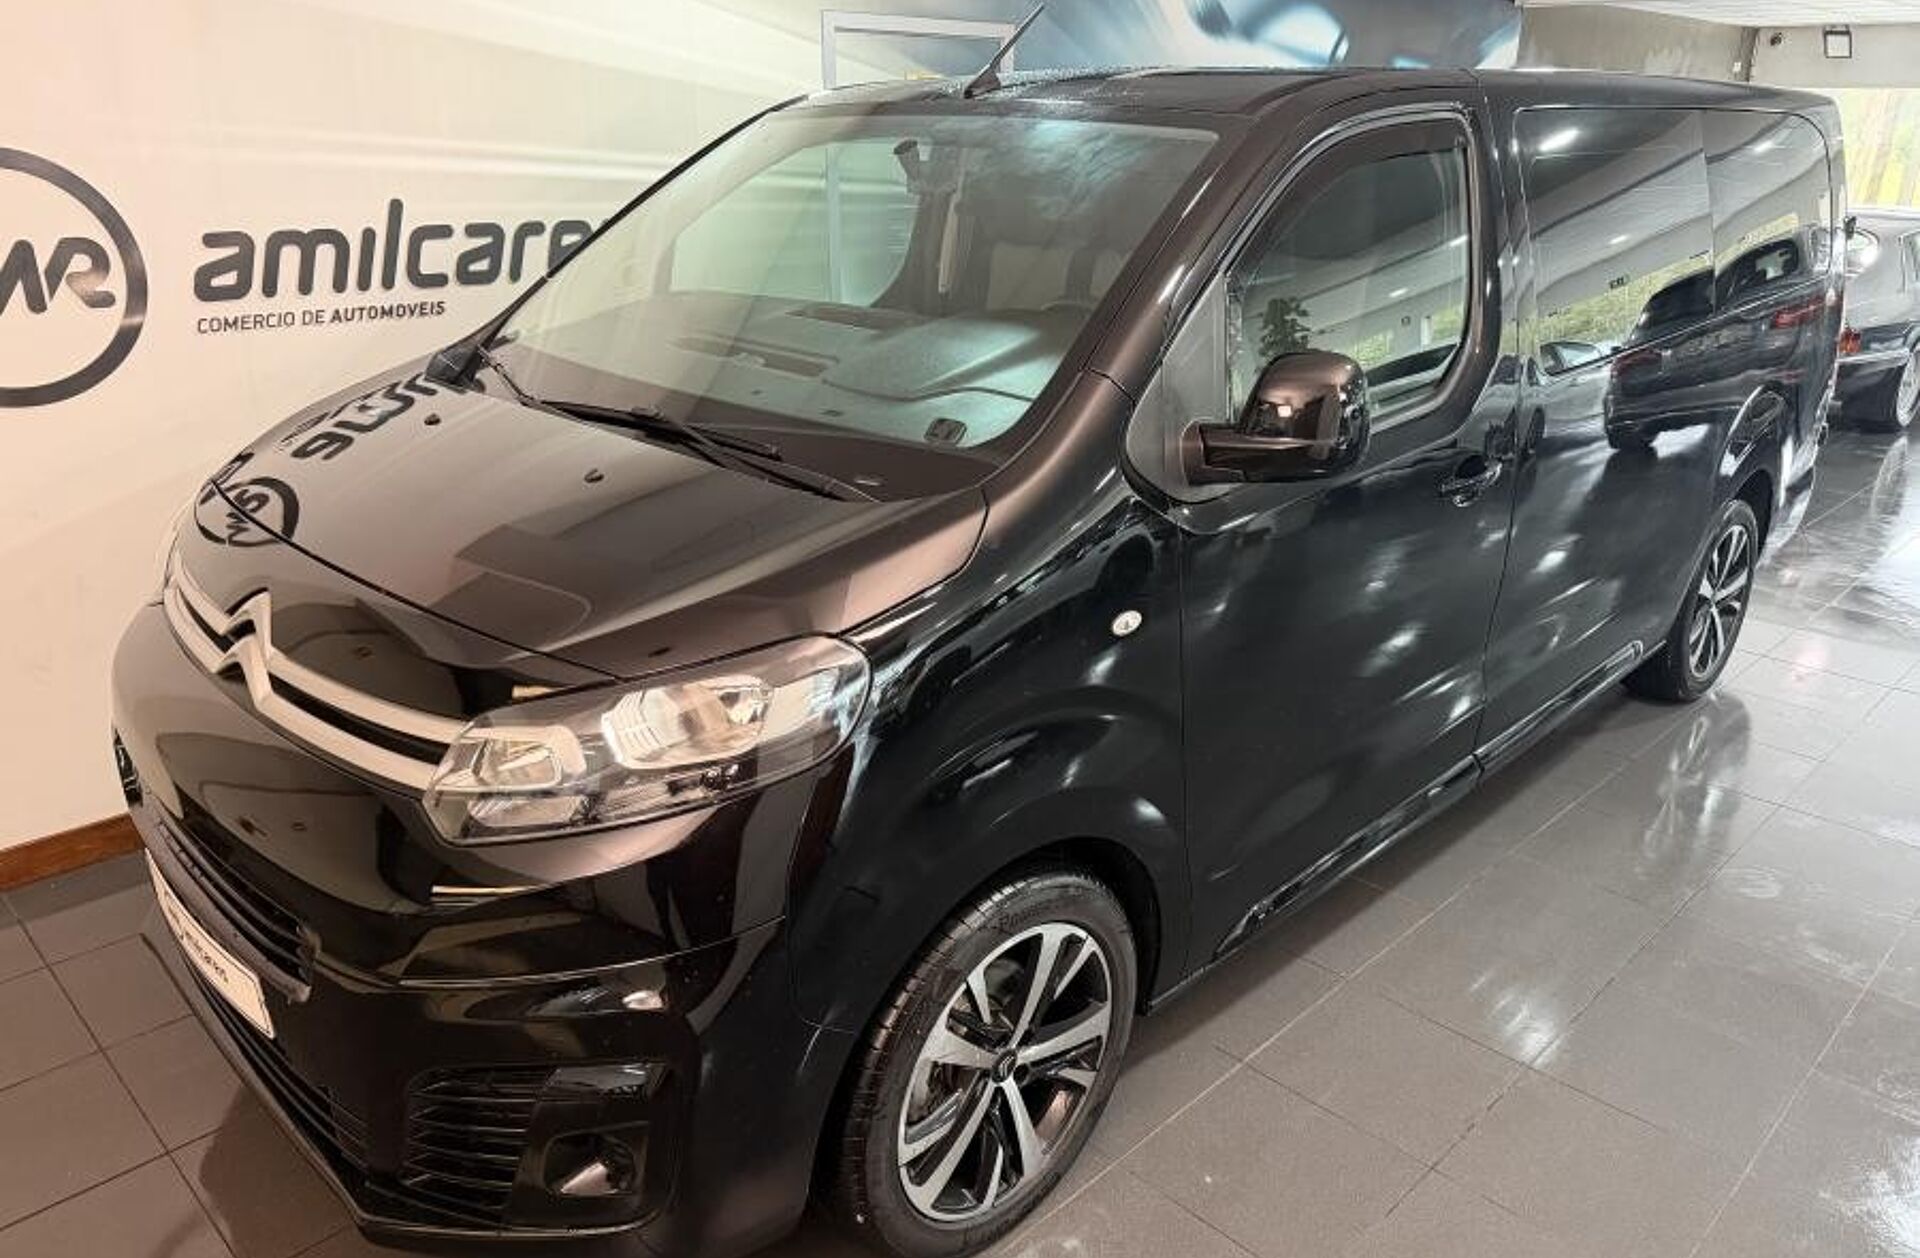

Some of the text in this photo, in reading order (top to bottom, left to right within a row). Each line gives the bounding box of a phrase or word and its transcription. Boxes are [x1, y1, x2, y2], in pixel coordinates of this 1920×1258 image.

[193, 198, 609, 302] amilcare
[196, 301, 447, 335] COMERCIO DE AUTOMOVEIS
